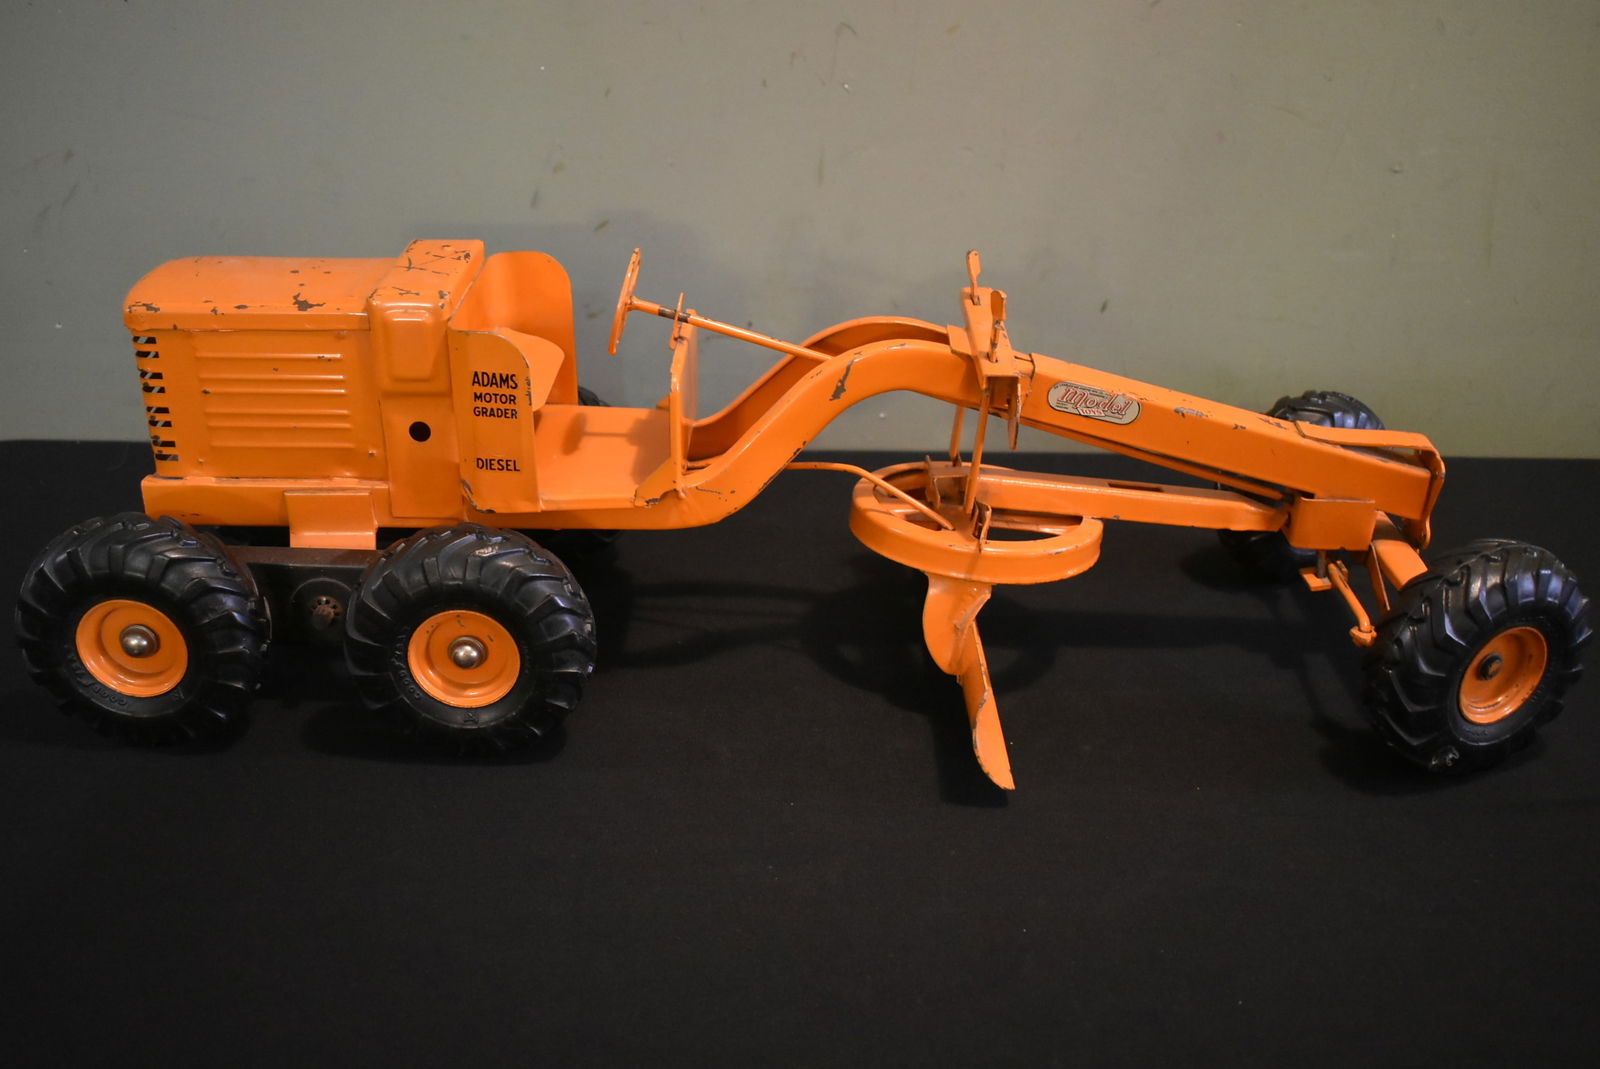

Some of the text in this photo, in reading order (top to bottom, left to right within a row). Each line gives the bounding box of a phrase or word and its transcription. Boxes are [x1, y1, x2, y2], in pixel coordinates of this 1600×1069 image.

[472, 371, 518, 389] ADAMS
[473, 391, 517, 405] MOTOR
[473, 406, 518, 419] GRADER
[476, 457, 521, 472] DIESEL
